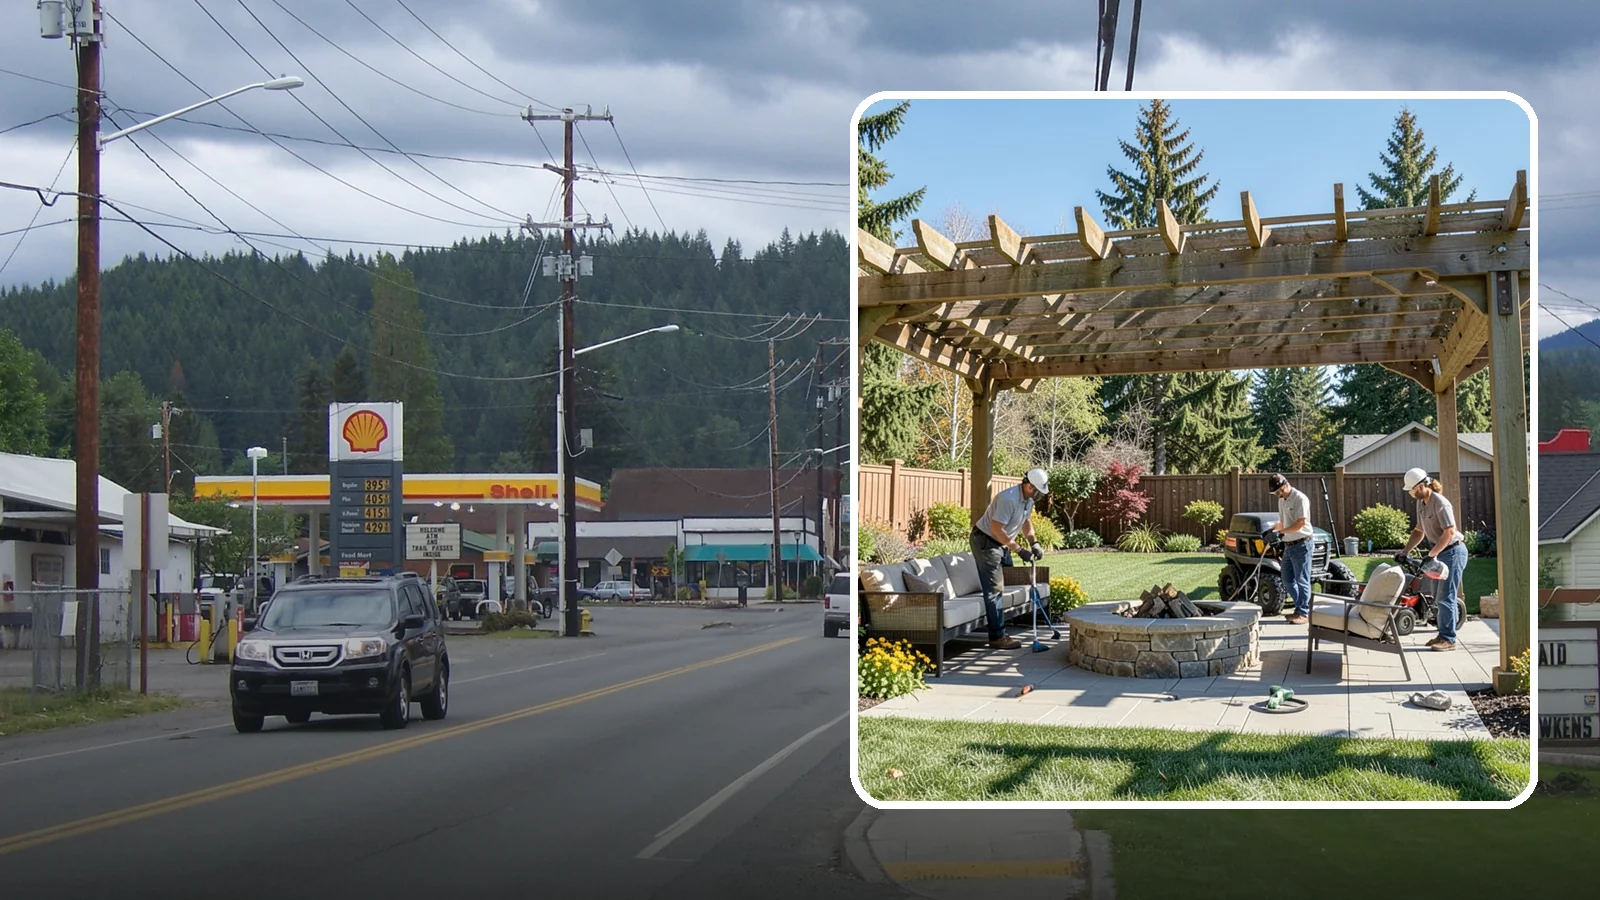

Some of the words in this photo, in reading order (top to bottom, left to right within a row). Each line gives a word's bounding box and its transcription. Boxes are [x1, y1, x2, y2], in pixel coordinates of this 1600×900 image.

[366, 480, 383, 490] 395
[490, 484, 547, 499] Shell
[366, 494, 383, 504] 405
[366, 508, 383, 518] 415
[366, 522, 383, 533] 429
